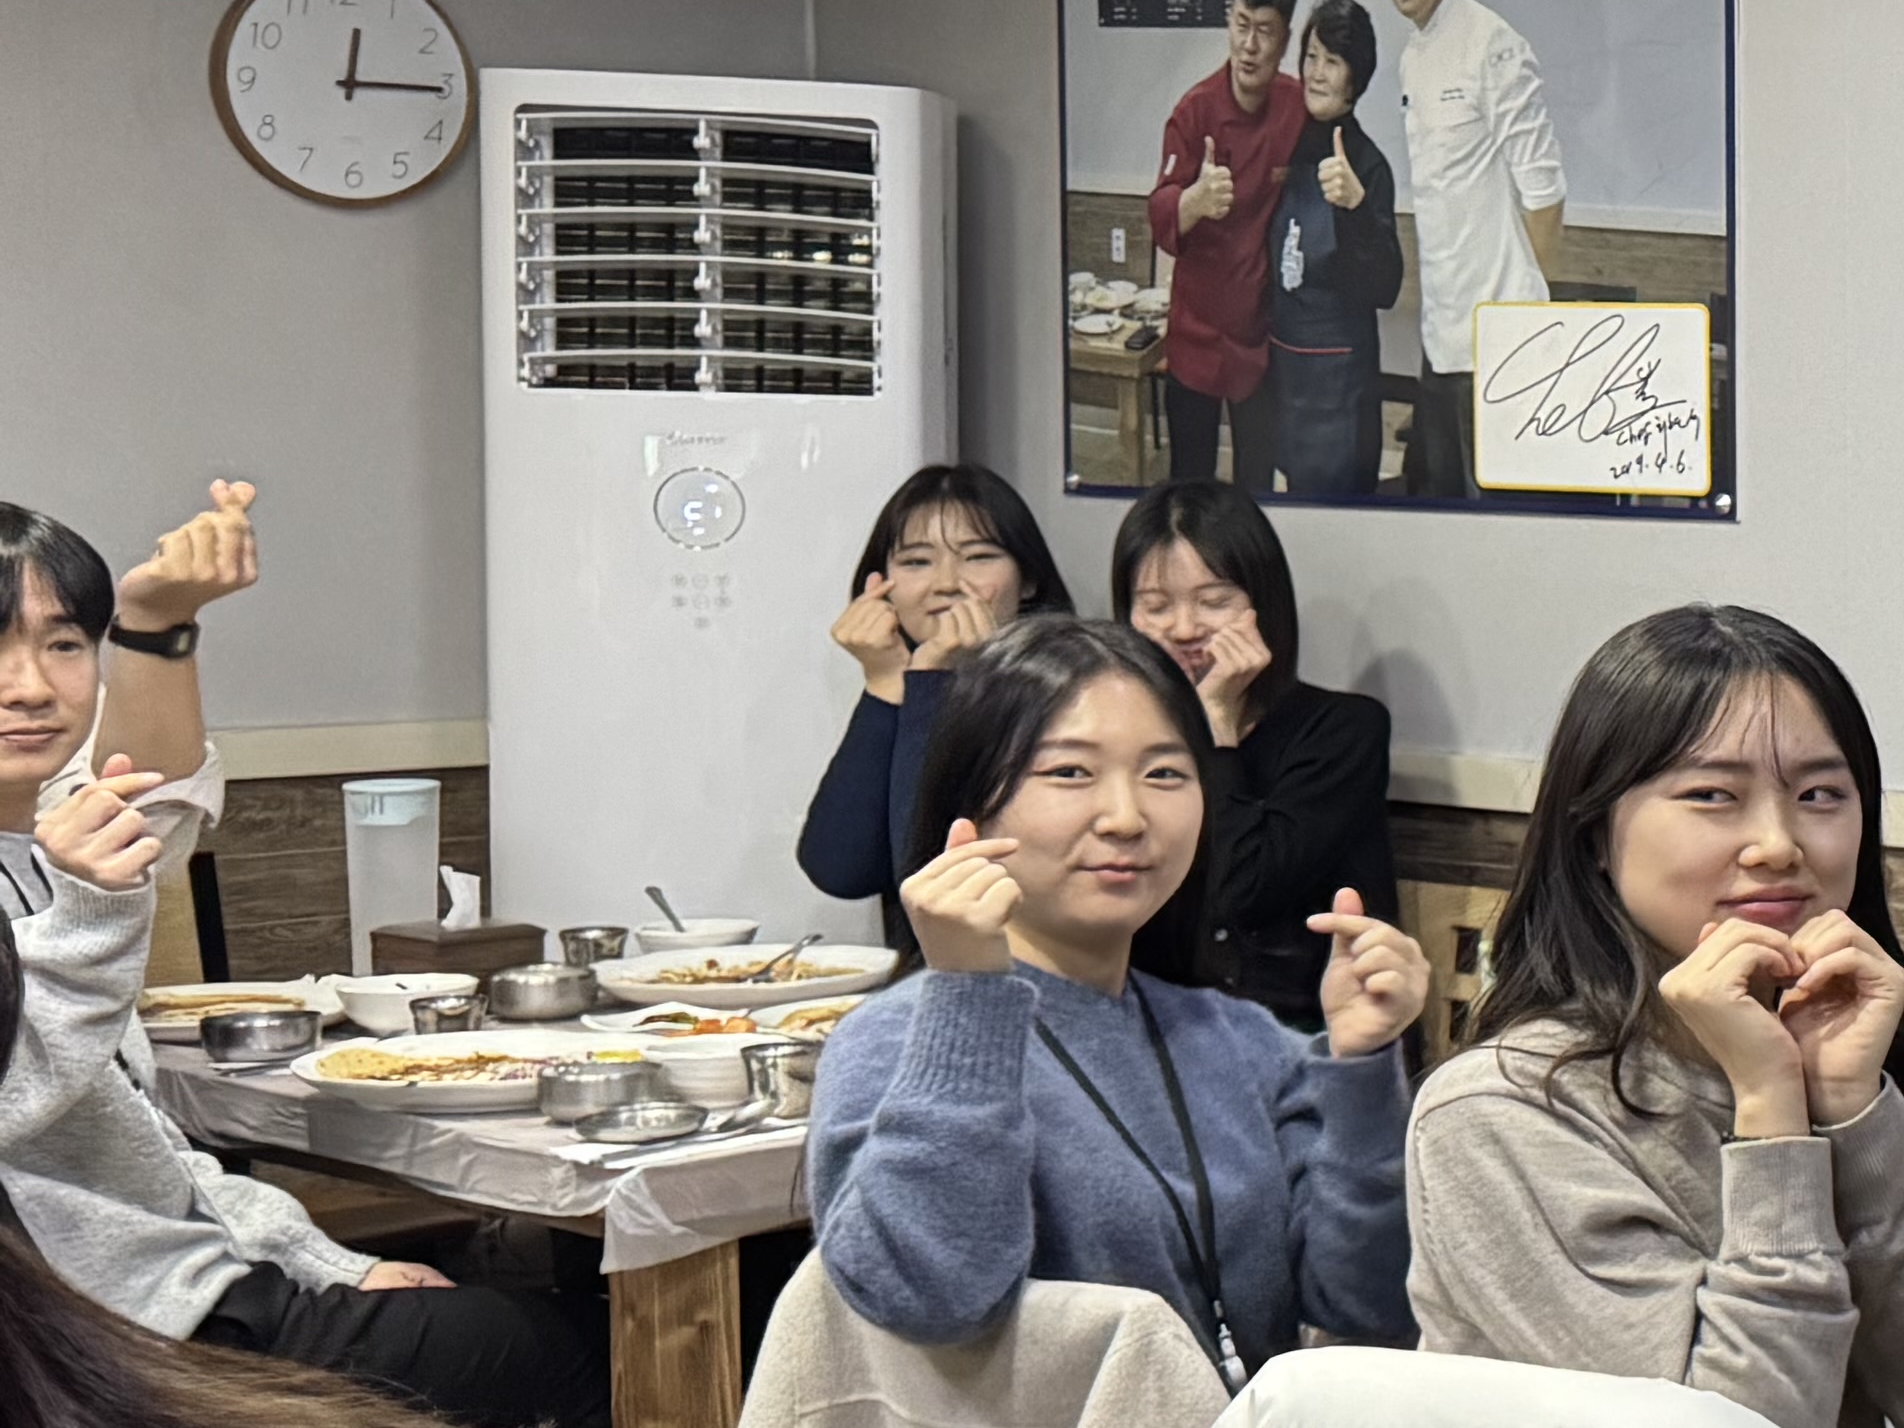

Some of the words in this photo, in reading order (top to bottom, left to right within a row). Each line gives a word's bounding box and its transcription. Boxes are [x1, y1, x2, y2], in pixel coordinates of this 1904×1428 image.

[252, 22, 282, 50] 10
[418, 28, 439, 54] 2
[237, 66, 257, 93] 9
[435, 73, 454, 99] 3
[257, 114, 276, 141] 8
[423, 120, 443, 144] 4
[298, 147, 314, 171] 7
[392, 152, 410, 179] 5
[345, 162, 364, 188] 6
